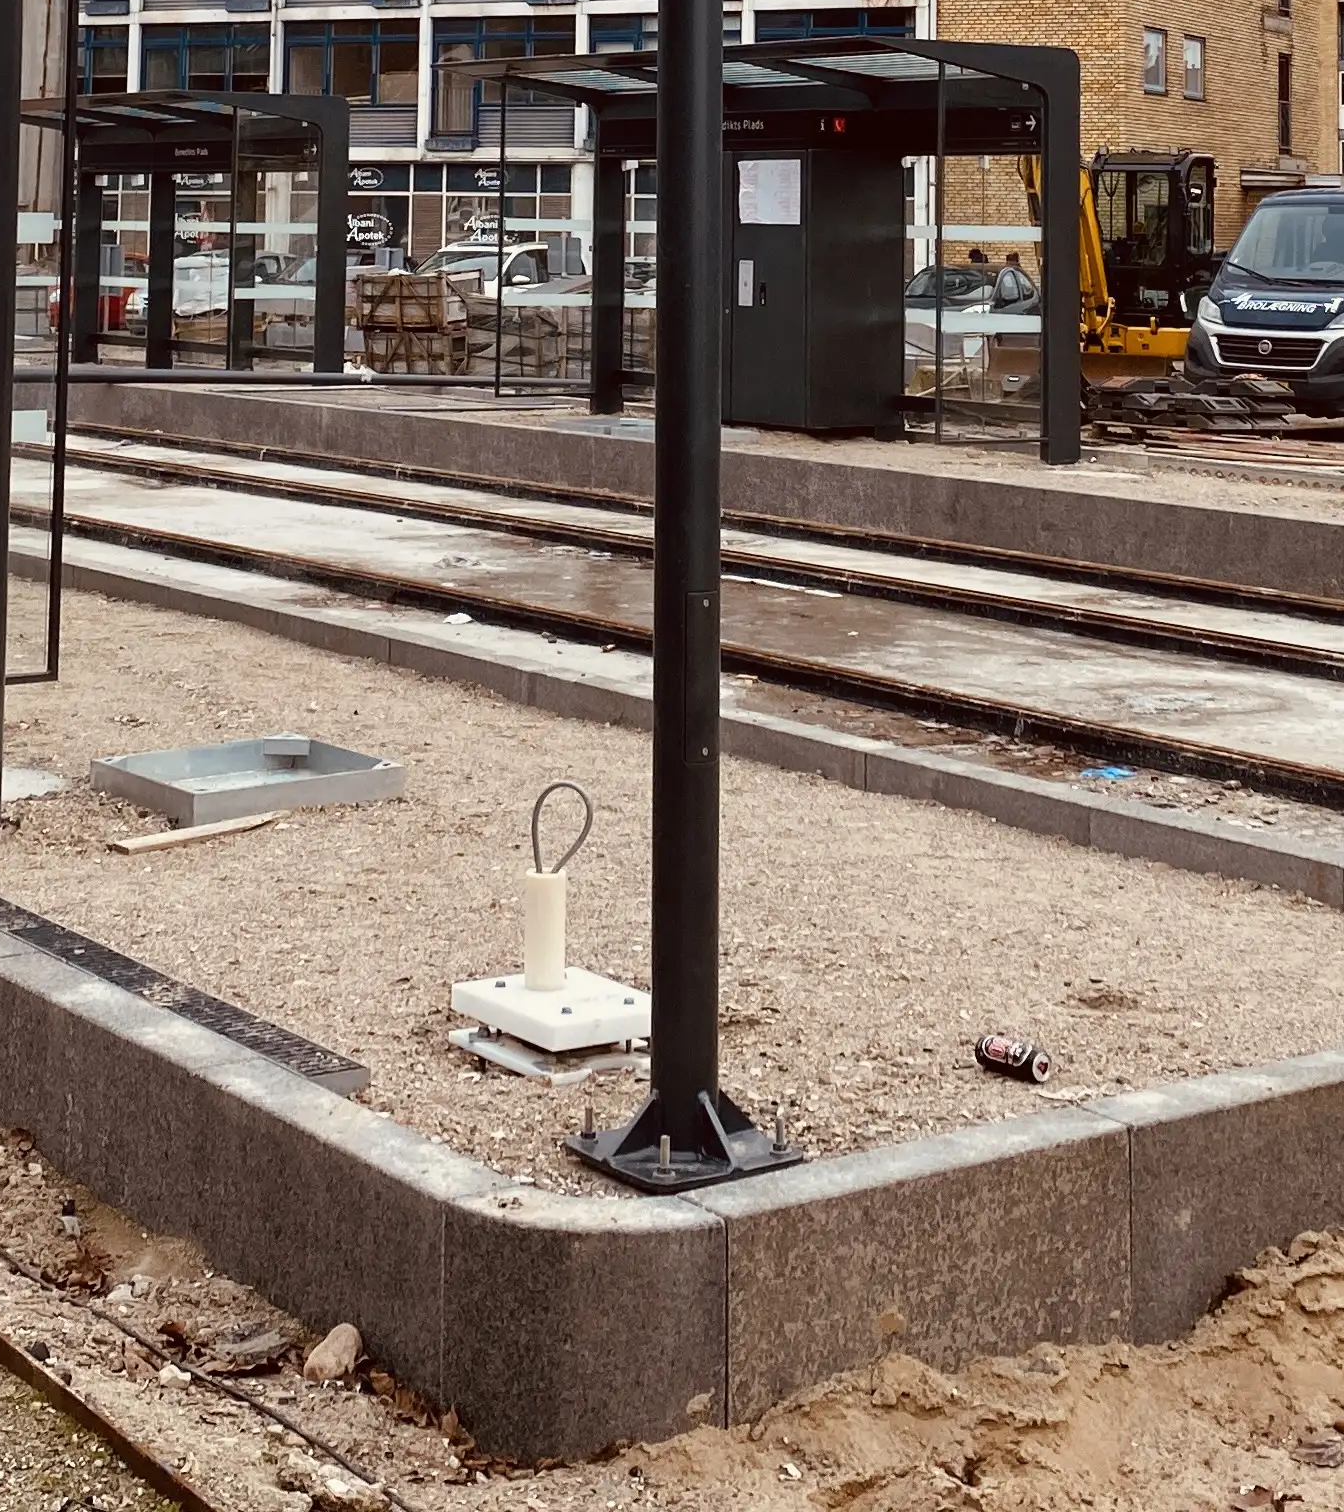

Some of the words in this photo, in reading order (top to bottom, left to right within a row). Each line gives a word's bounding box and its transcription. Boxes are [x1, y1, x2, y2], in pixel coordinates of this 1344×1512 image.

[743, 119, 764, 130] Plads
[463, 215, 499, 230] Albani
[346, 226, 385, 241] Apotek
[1236, 300, 1317, 314] BROLÆGNING
